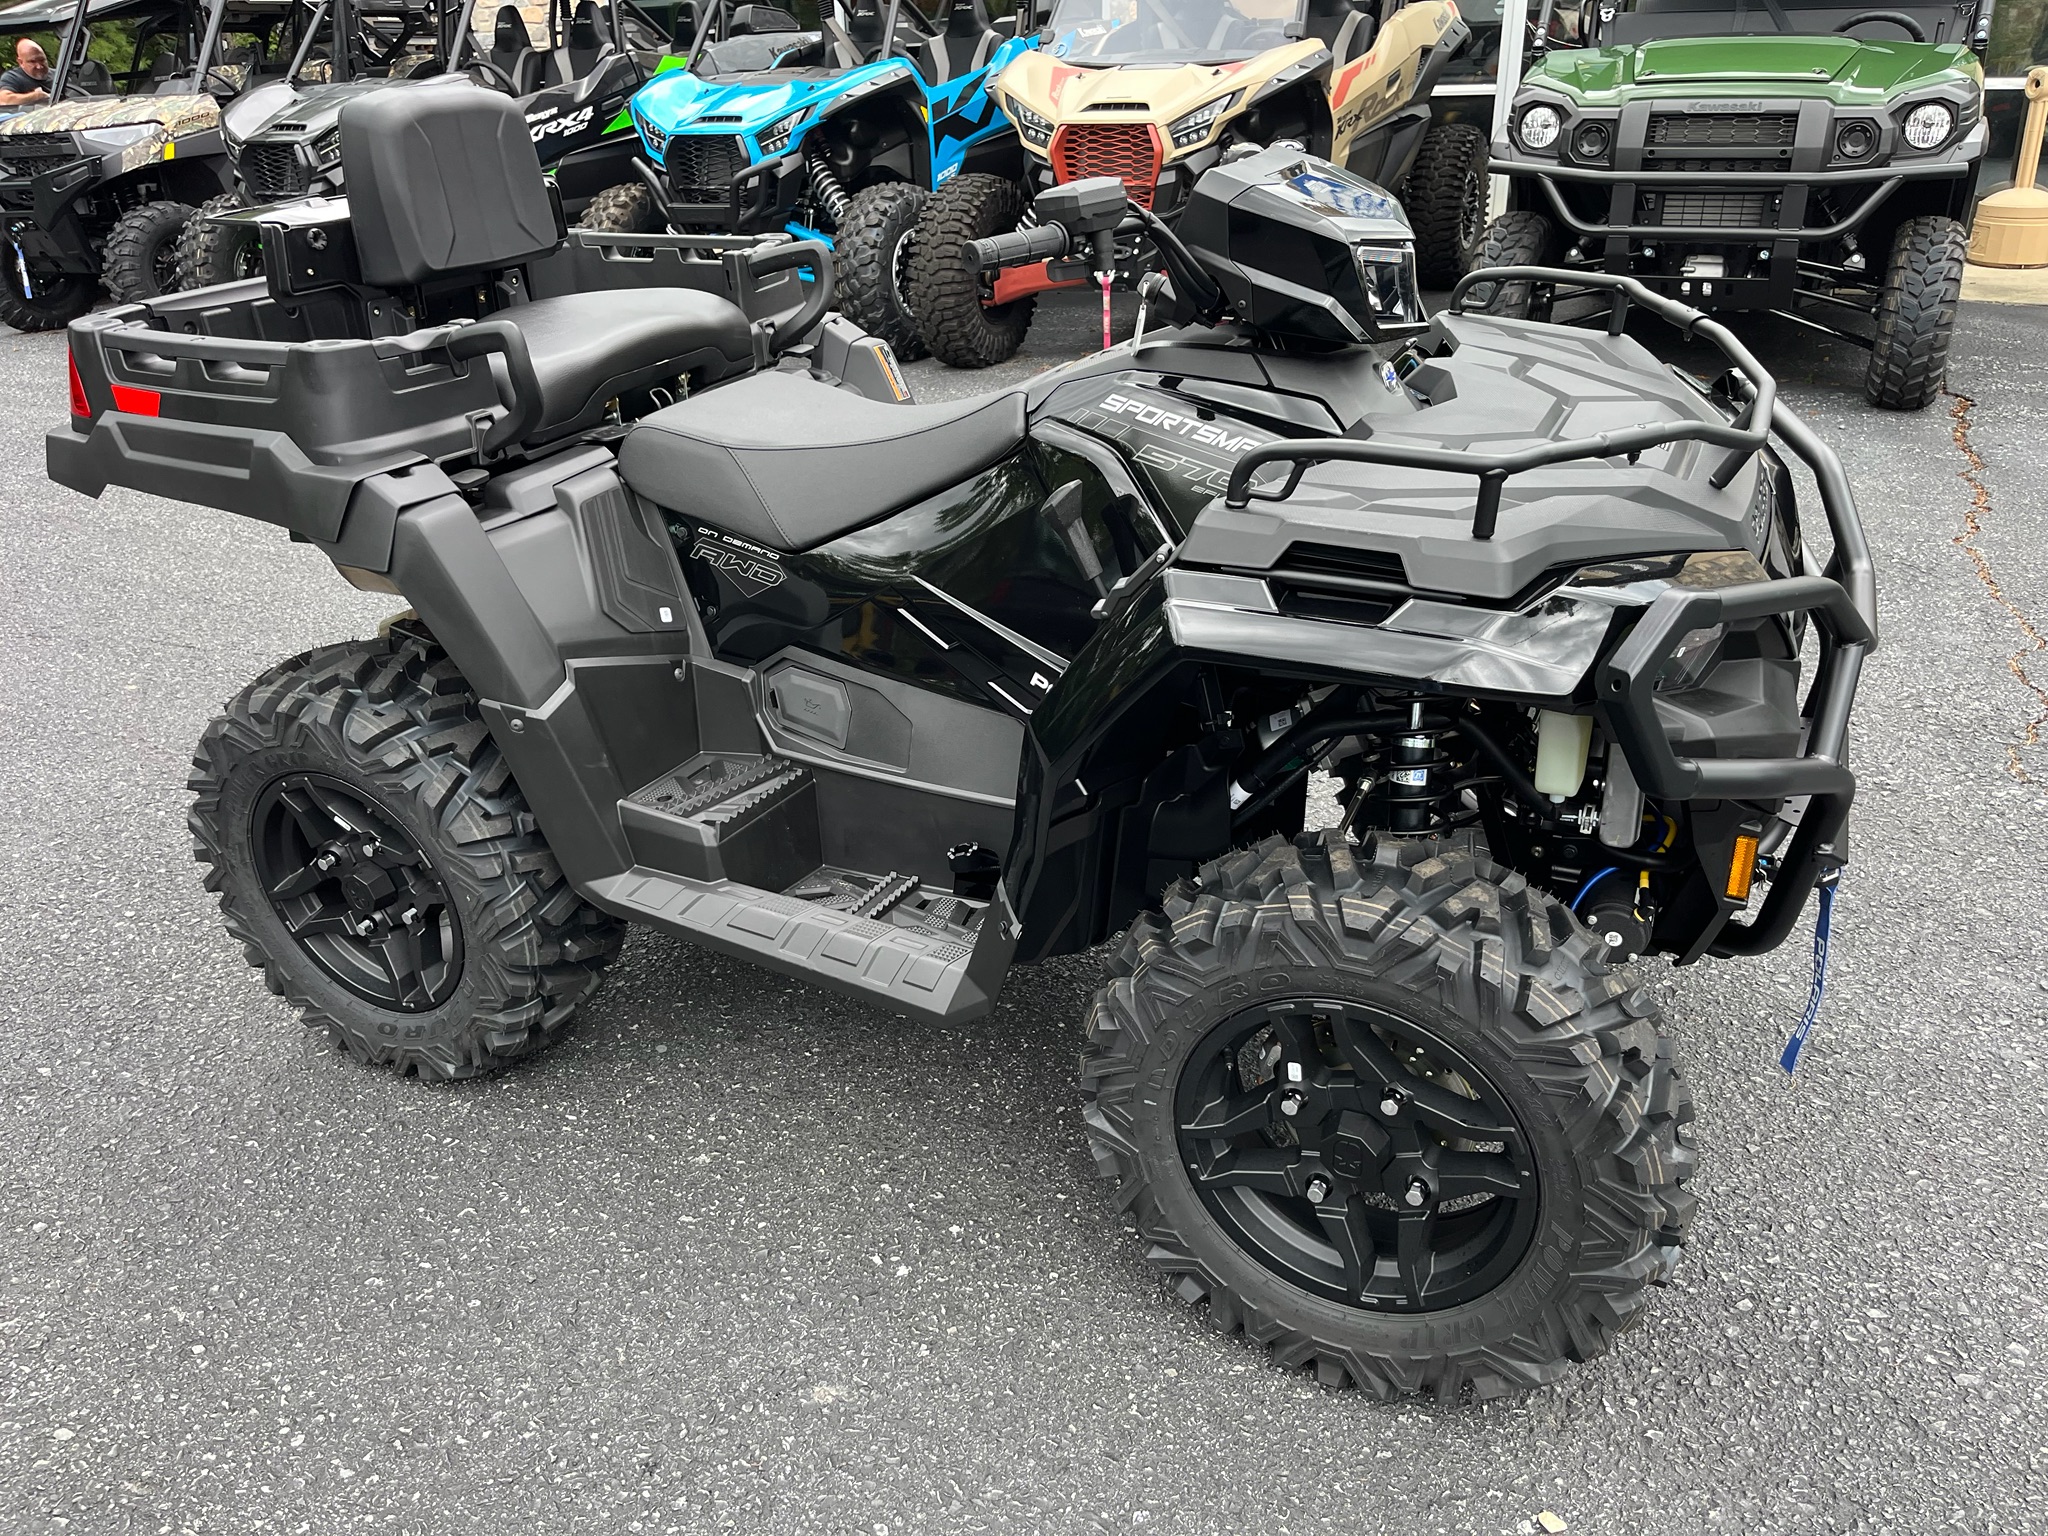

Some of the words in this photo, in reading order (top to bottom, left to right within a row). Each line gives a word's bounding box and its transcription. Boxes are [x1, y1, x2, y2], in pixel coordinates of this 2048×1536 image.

[174, 112, 210, 128] 1000
[1686, 101, 1763, 112] Kawasaki
[562, 121, 589, 137] 1000
[936, 162, 959, 183] 1000
[1099, 393, 1263, 452] SPORTSMA
[689, 542, 784, 587] AWD
[1795, 936, 1826, 1041] POLARIS
[1158, 971, 1293, 1064] DURO
